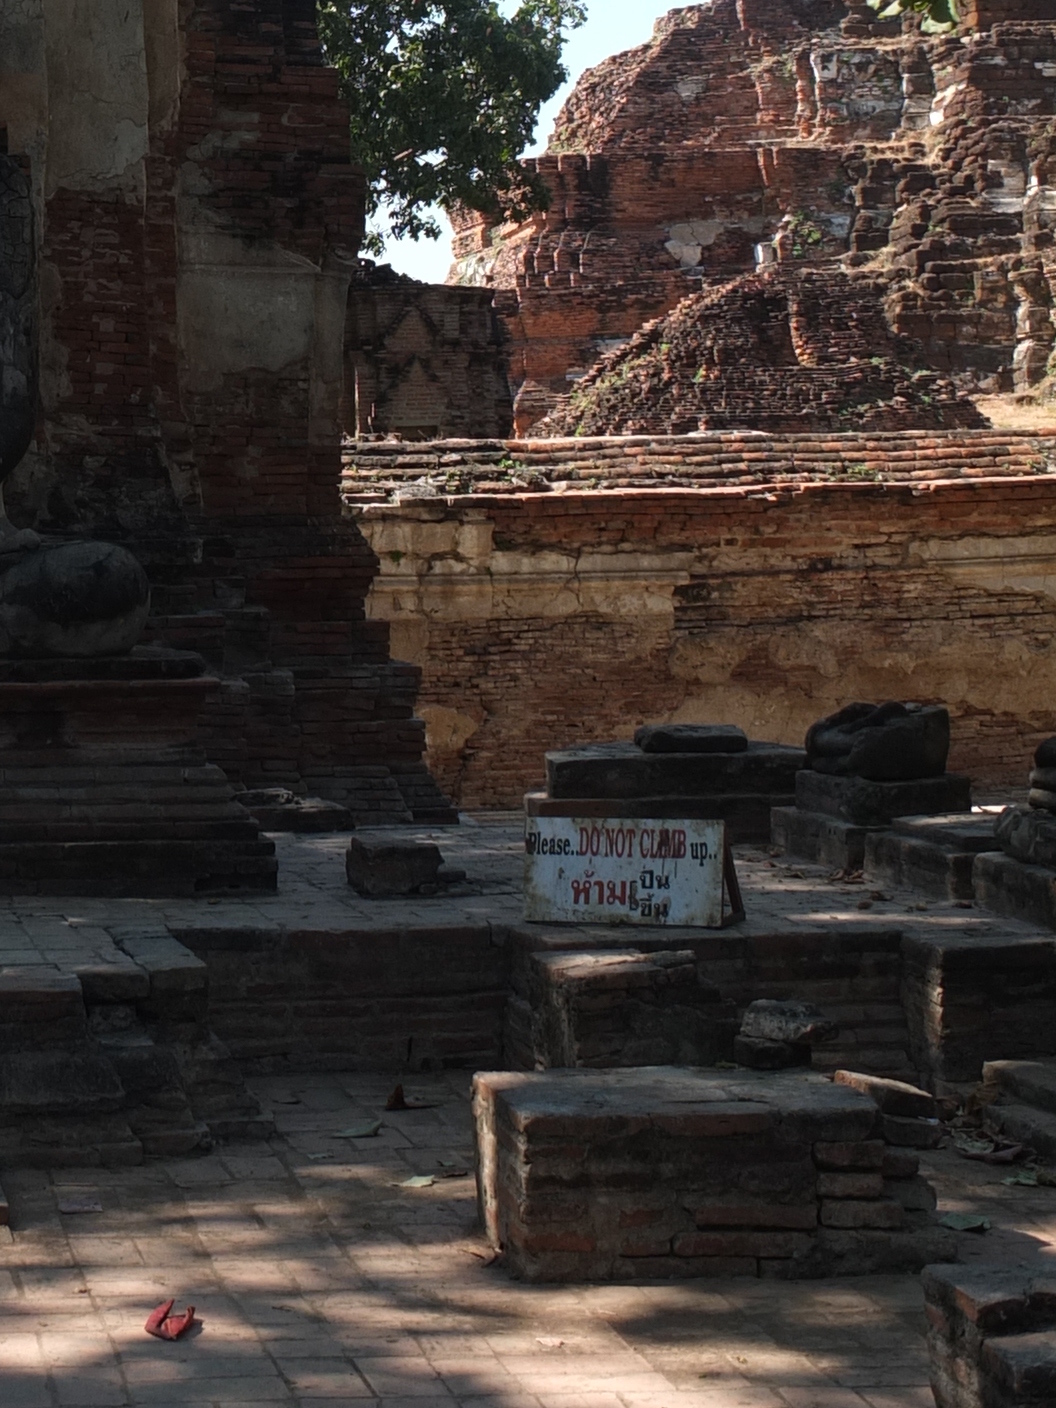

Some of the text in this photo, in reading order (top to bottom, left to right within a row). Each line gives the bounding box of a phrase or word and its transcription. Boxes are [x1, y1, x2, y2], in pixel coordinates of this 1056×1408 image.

[579, 826, 601, 857] DO
[604, 827, 636, 858] NOT
[639, 828, 687, 859] CLIMB
[571, 869, 627, 905] ห้าม
